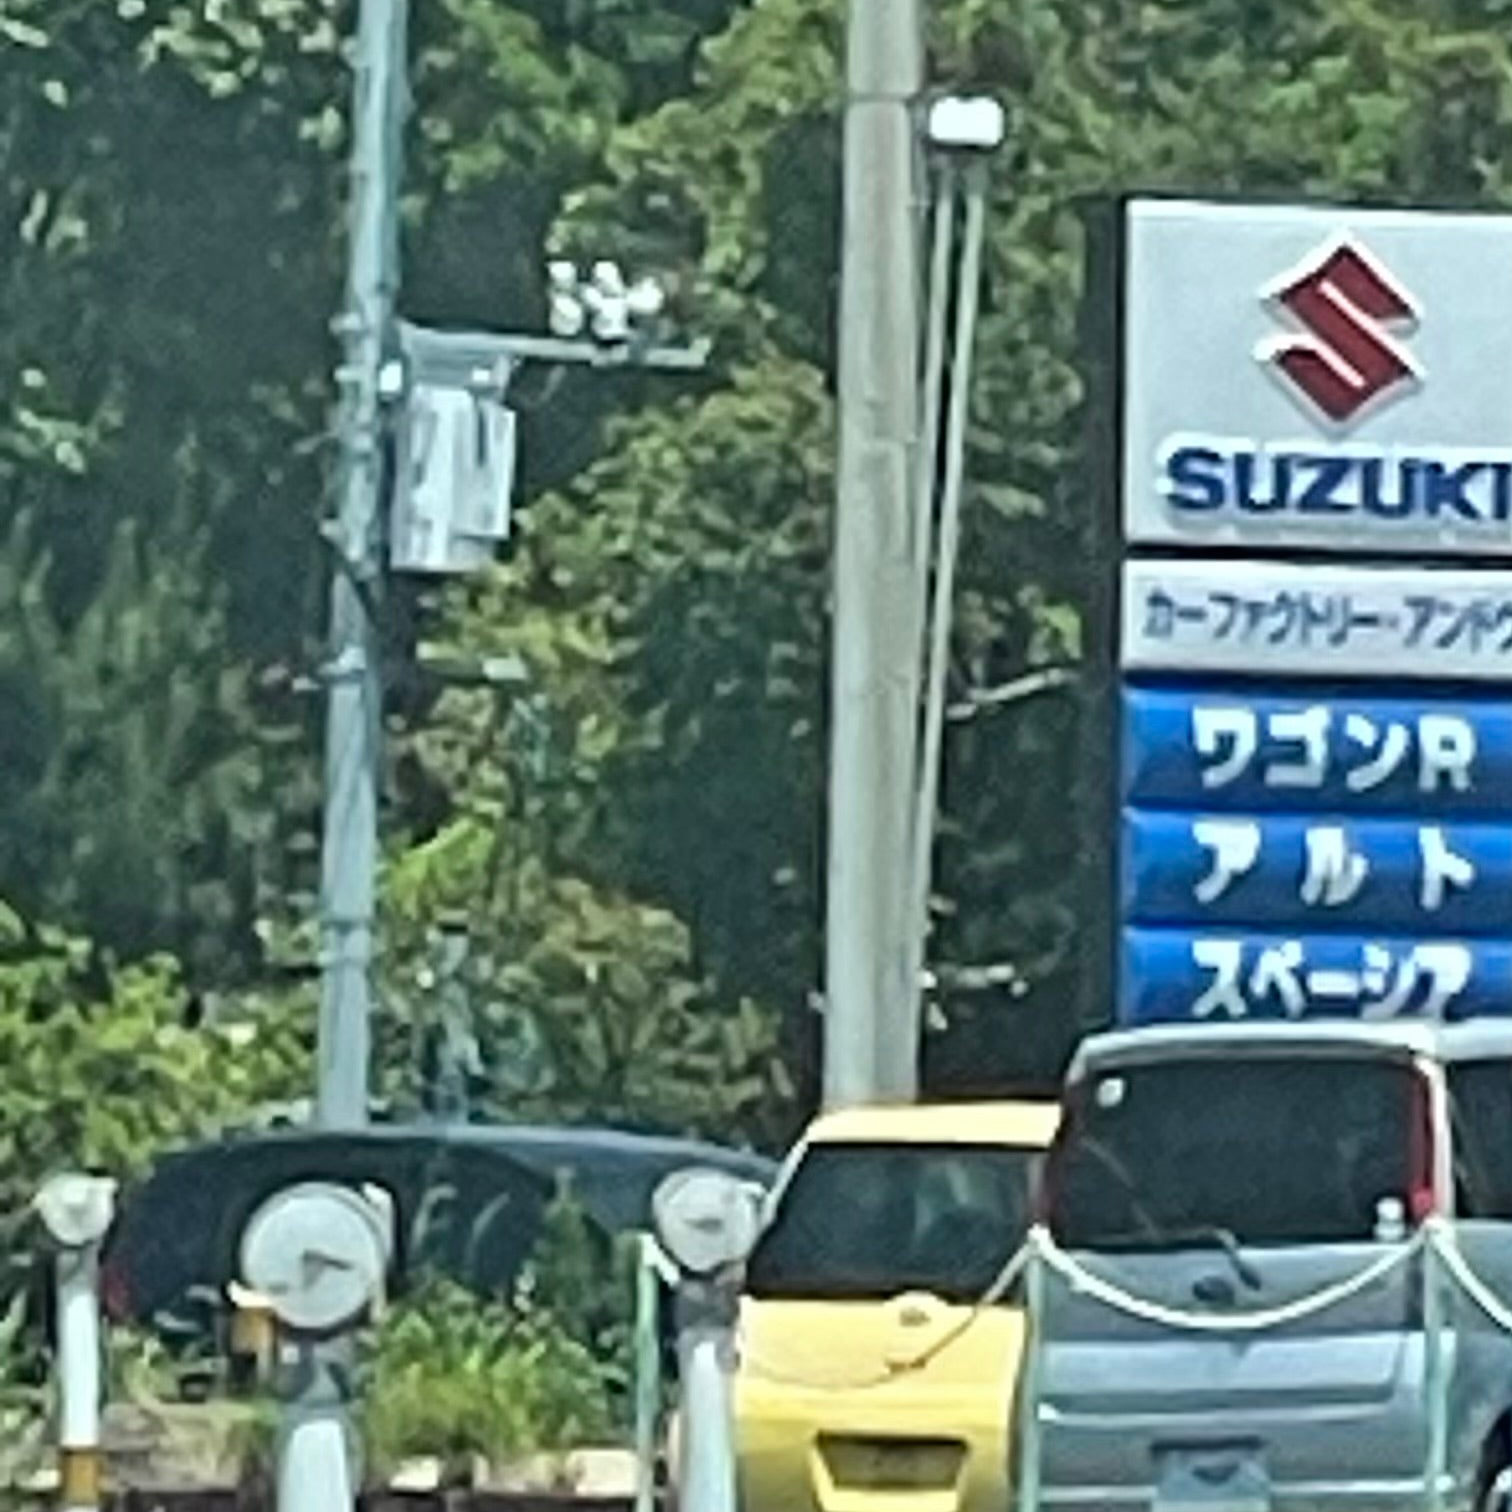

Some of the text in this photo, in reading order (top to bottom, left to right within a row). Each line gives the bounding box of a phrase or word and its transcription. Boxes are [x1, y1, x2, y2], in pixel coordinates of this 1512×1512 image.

[1191, 705, 1478, 792] ワゴンR
[1192, 820, 1475, 911] アルト
[1190, 939, 1473, 1021] スペーシア
